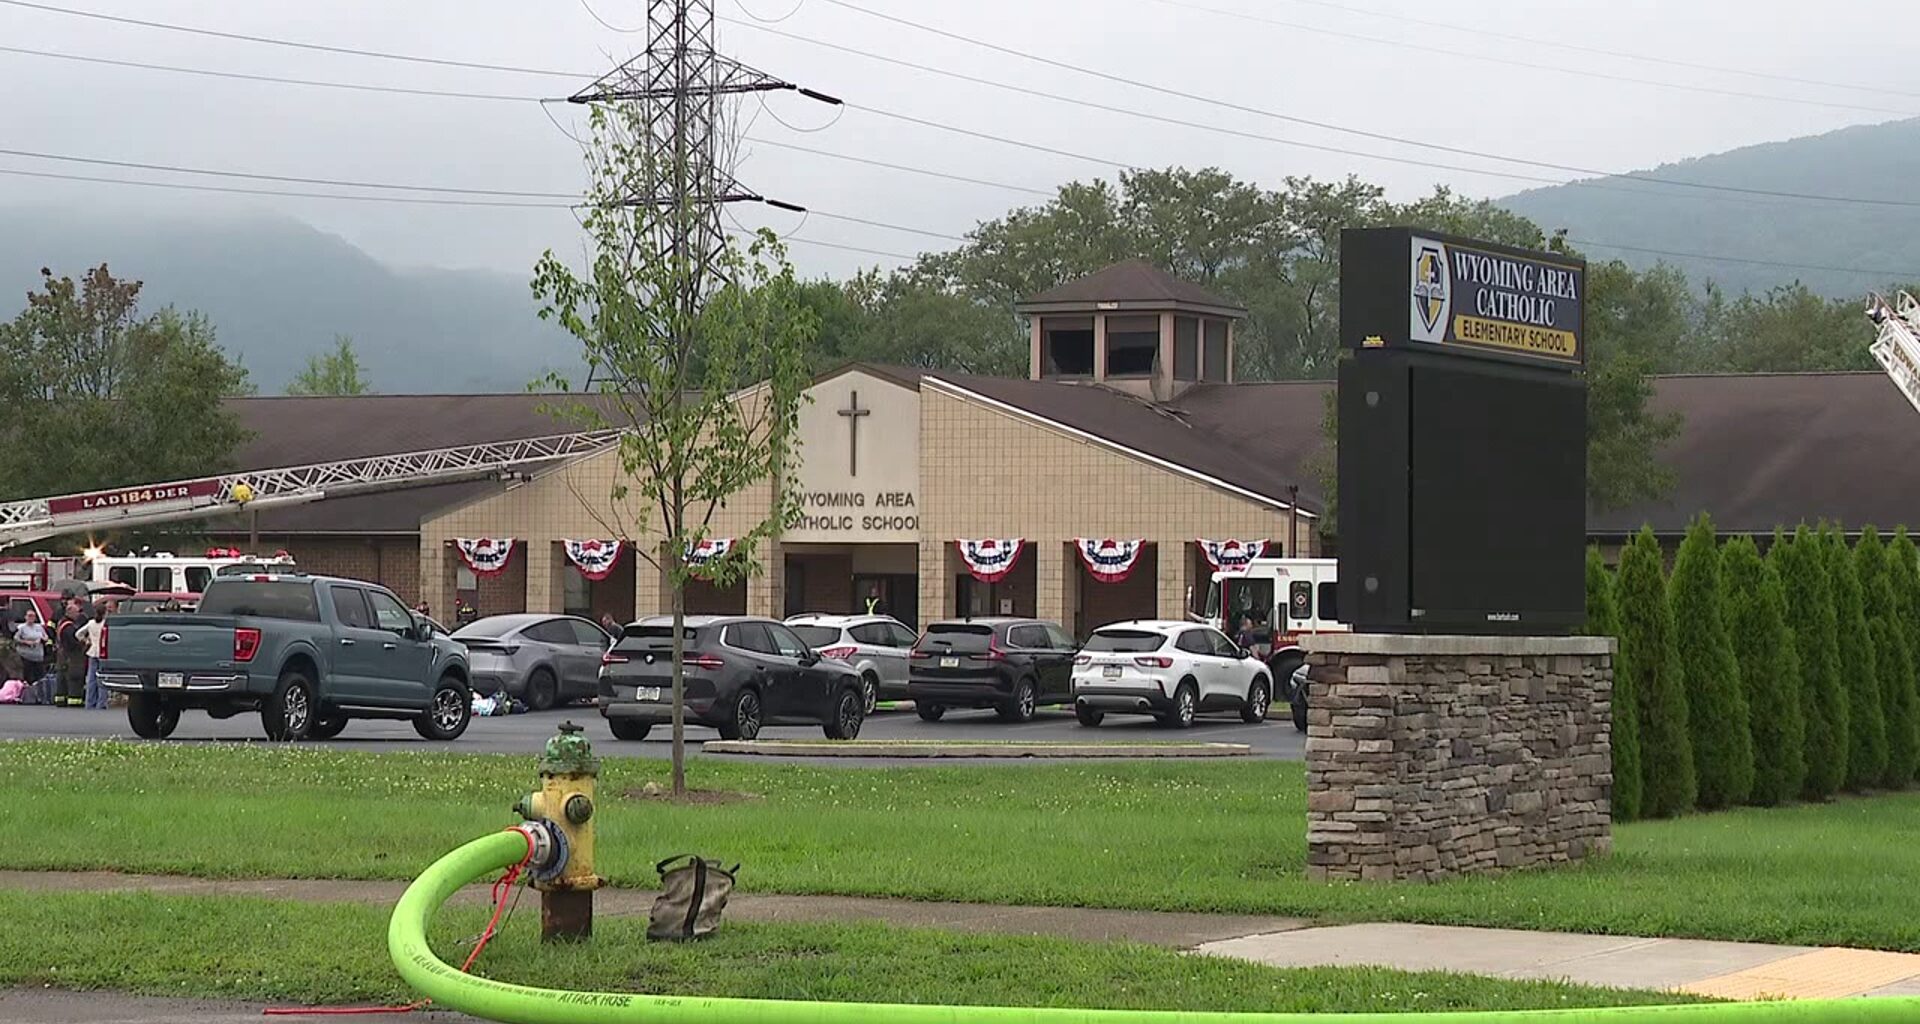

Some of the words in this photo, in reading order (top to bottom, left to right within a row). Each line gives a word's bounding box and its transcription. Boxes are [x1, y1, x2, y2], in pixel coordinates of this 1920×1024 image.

[1455, 252, 1533, 292] WYOMING
[1537, 267, 1577, 300] AREA
[1477, 287, 1555, 327] CATHOLIC
[1463, 319, 1527, 347] ELEMENTARY
[1528, 330, 1567, 352] SCHOOL
[875, 492, 915, 507] AREA
[557, 993, 601, 1006] ATTACK
[600, 995, 633, 1007] HOSE
